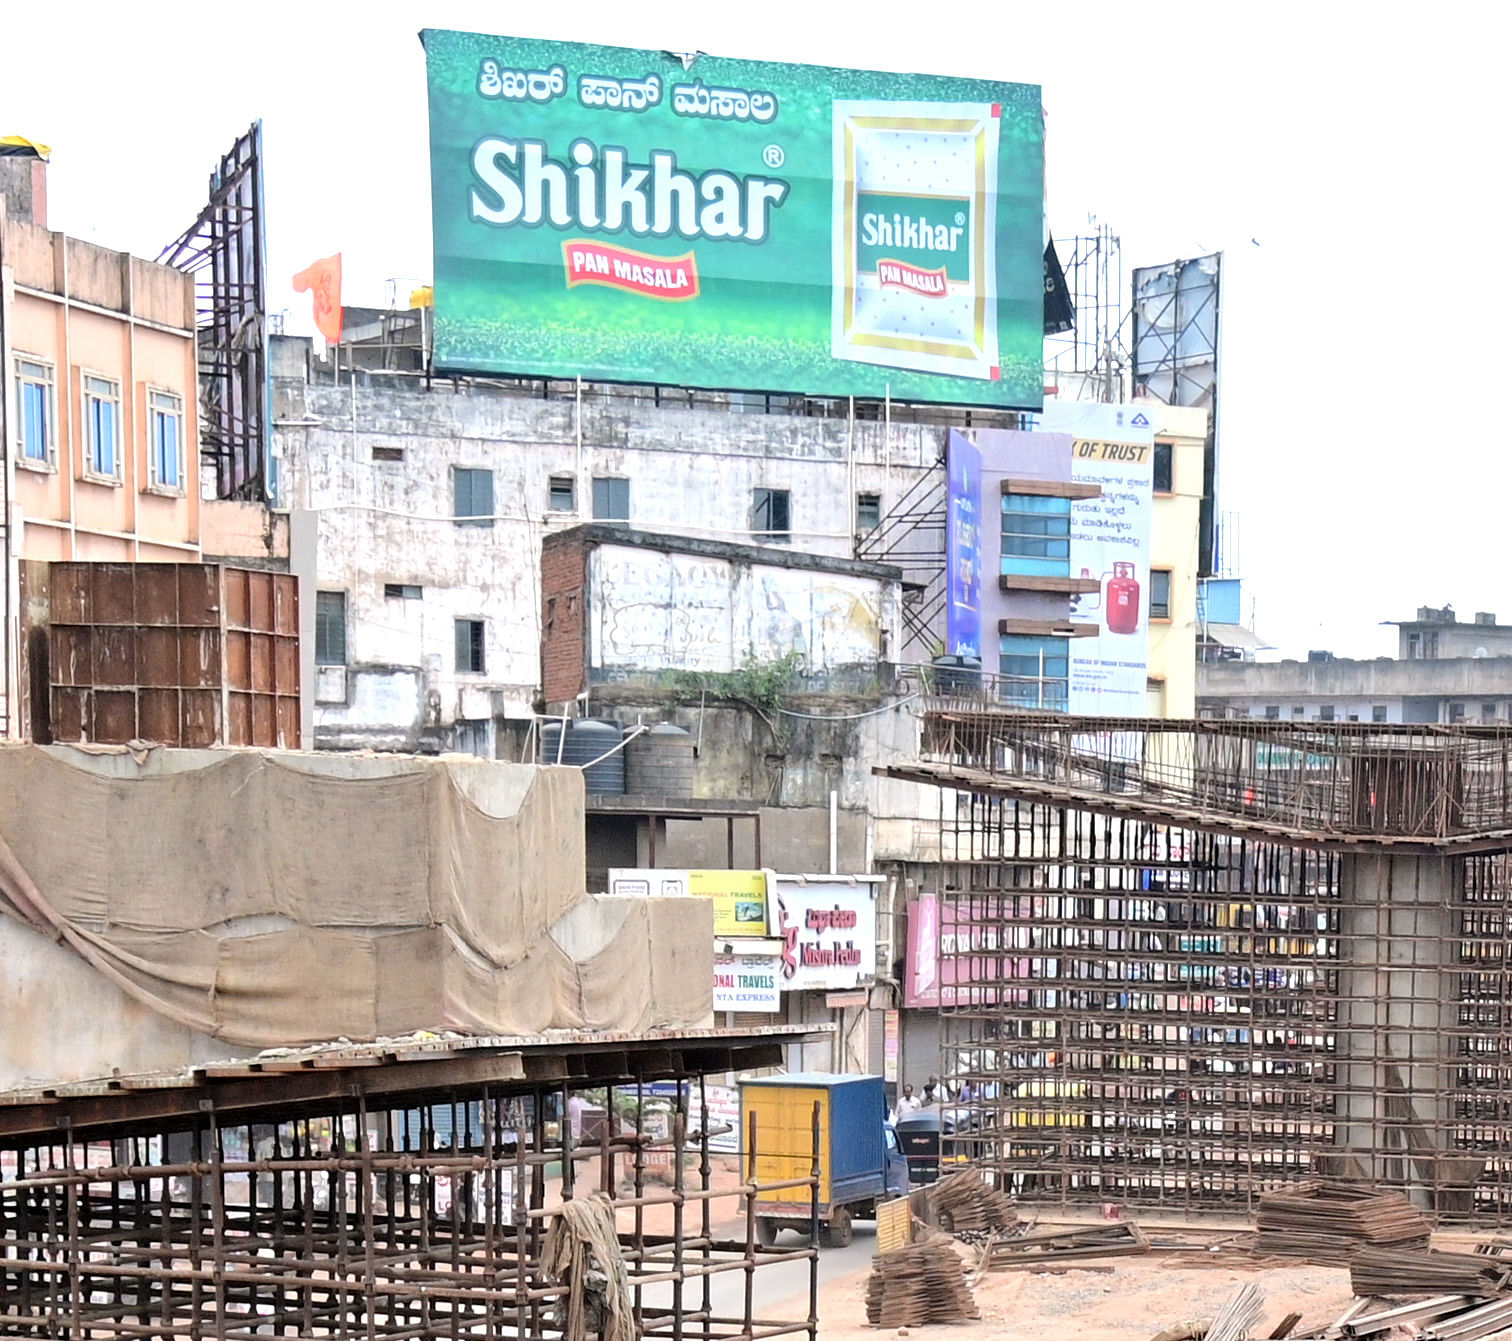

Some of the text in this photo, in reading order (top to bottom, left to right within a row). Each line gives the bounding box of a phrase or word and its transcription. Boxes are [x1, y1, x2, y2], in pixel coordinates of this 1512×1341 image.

[479, 59, 776, 121] ಶಿಖರ್ ಪಾನ್ ಮಸಾಲ
[471, 138, 788, 242] Shikhar
[862, 213, 963, 252] Shikhar
[573, 251, 688, 288] PAN MASALA
[902, 268, 943, 291] MASALA
[1079, 441, 1148, 462] OF TRUST
[738, 975, 775, 989] TRAVELS
[736, 994, 775, 1002] EXPRESS
